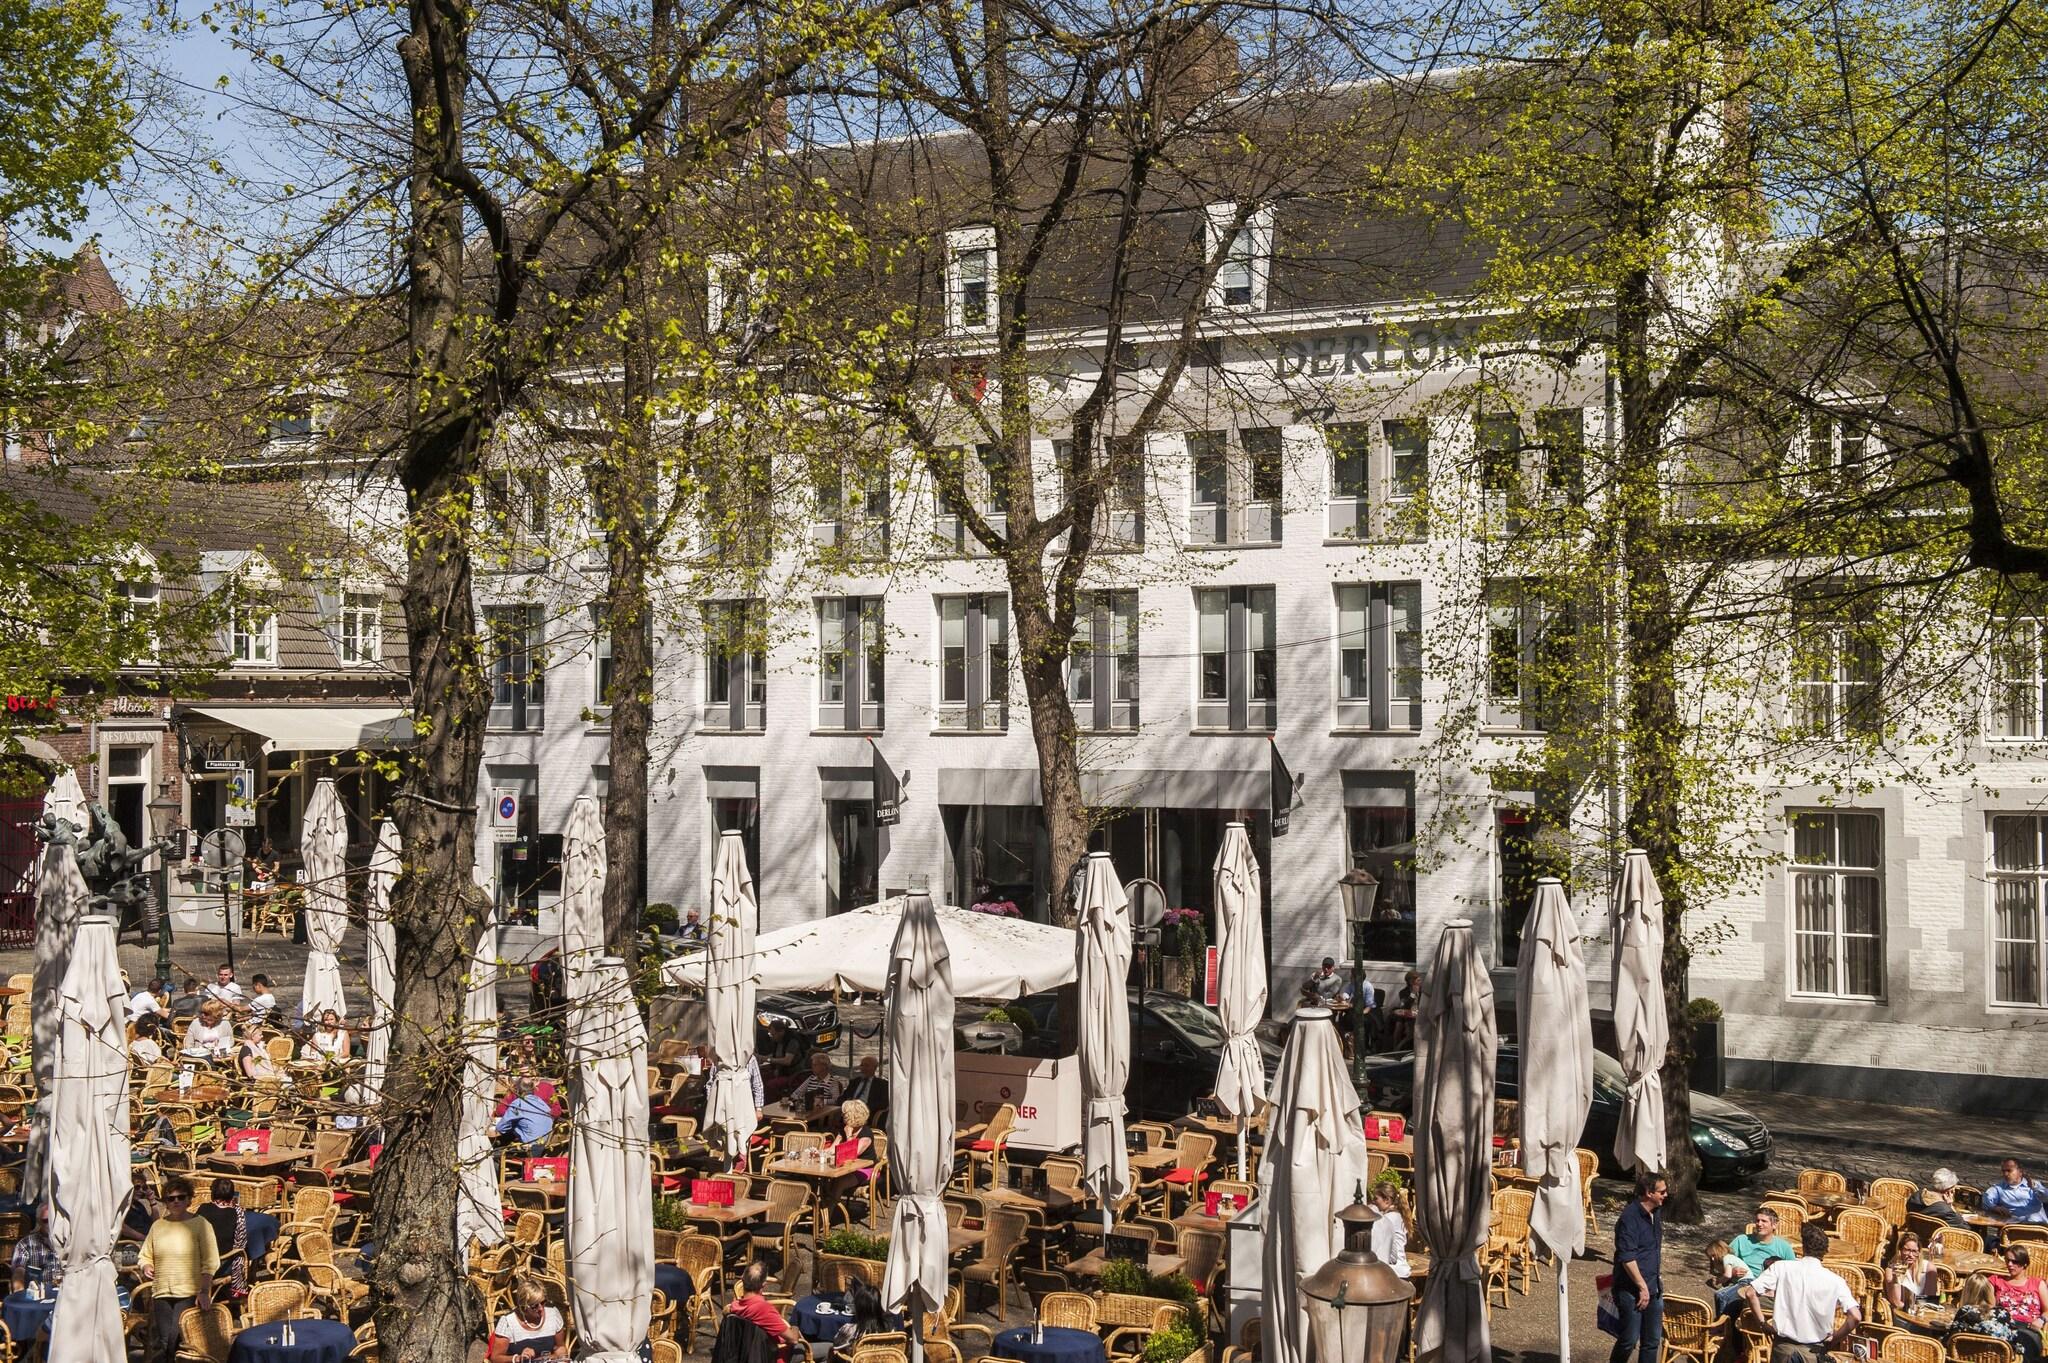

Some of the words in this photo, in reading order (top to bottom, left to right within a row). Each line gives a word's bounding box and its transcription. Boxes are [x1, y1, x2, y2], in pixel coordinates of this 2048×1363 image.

[1275, 327, 1479, 378] DERLON
[103, 731, 160, 742] RESTAURANT
[877, 808, 899, 818] DERLON
[974, 1101, 1037, 1120] GNER
